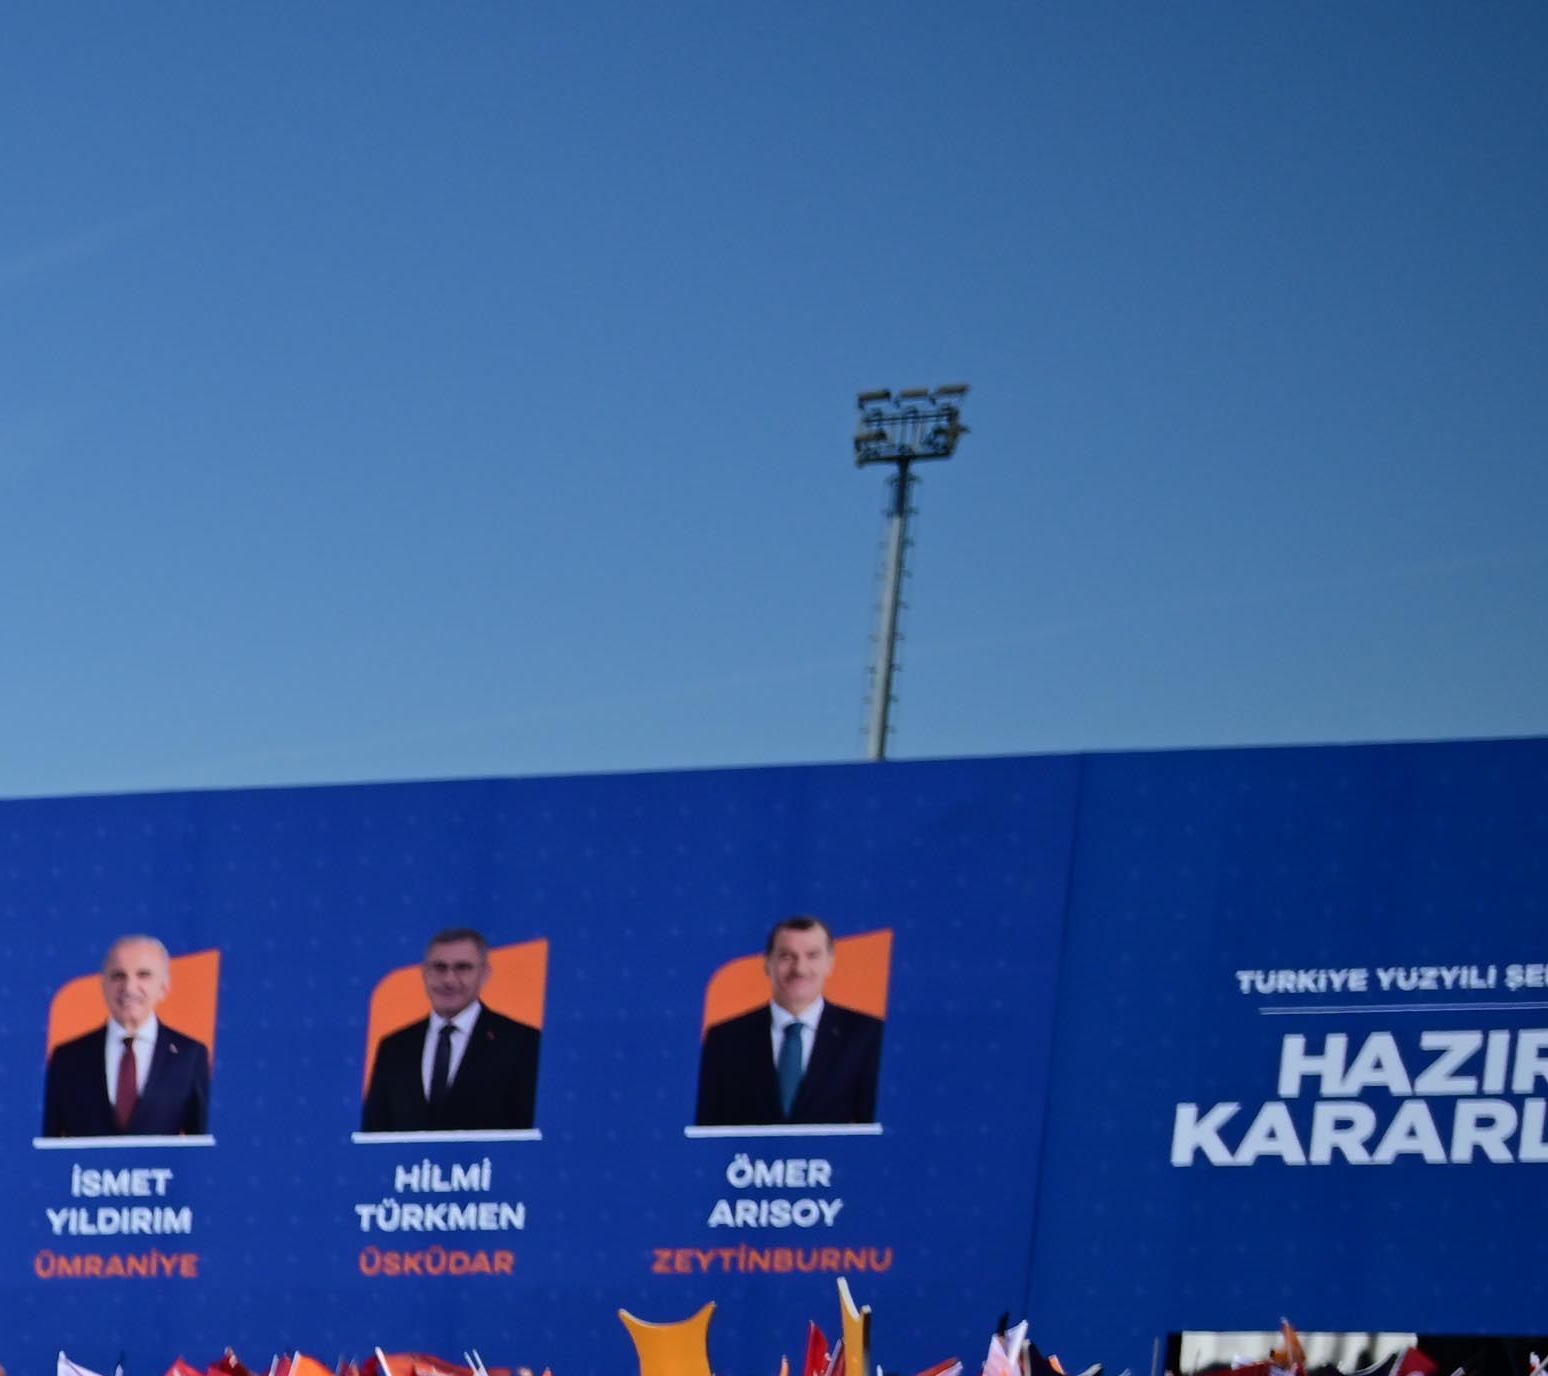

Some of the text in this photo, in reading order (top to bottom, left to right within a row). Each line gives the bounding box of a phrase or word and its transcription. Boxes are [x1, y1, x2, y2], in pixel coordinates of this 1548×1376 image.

[1503, 961, 1548, 992] ŞE
[71, 1163, 173, 1198] İSMET
[394, 1156, 492, 1193] HİLMİ
[725, 1153, 833, 1188] ÖMER
[46, 1206, 192, 1236] YILDIRIM
[355, 1197, 526, 1233] TÜRKMEN
[708, 1197, 843, 1228] ARISOY
[359, 1244, 515, 1276] ÜSKÜDAR
[652, 1243, 894, 1273] ZEYTİNBURNU
